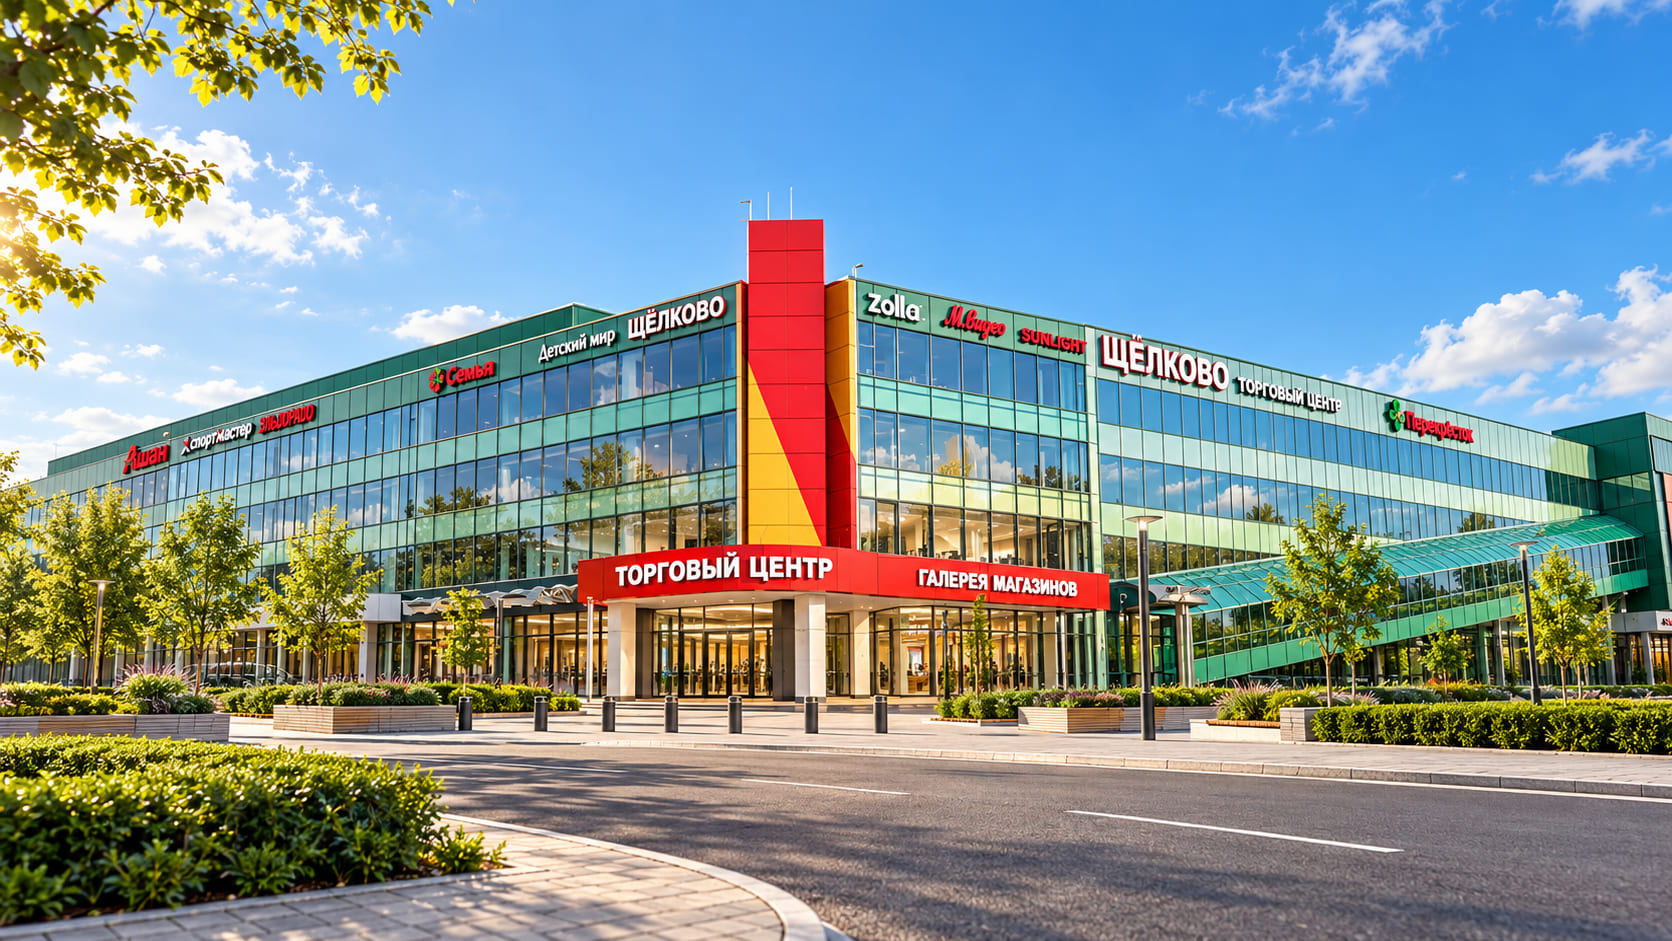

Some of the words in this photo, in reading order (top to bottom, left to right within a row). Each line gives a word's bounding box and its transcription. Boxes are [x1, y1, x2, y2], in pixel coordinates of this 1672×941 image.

[627, 295, 726, 340] ЩЁЛКОВО
[538, 332, 588, 363] Детский
[589, 329, 616, 349] мир
[1021, 328, 1087, 354] SUNLIGHT
[445, 361, 495, 386] Семья
[1101, 333, 1230, 392] ЩЁЛКОВО
[1237, 377, 1304, 406] ТОРГОВЫЙ
[1307, 392, 1342, 412] ЦЕНТР
[122, 444, 169, 474] Ашан
[615, 551, 740, 587] ТОРГОВЫЙ
[749, 556, 833, 582] ЦЕНТР
[919, 569, 988, 590] ГАЛЕРЕЯ
[993, 575, 1077, 597] МАГАЗИНОВ
